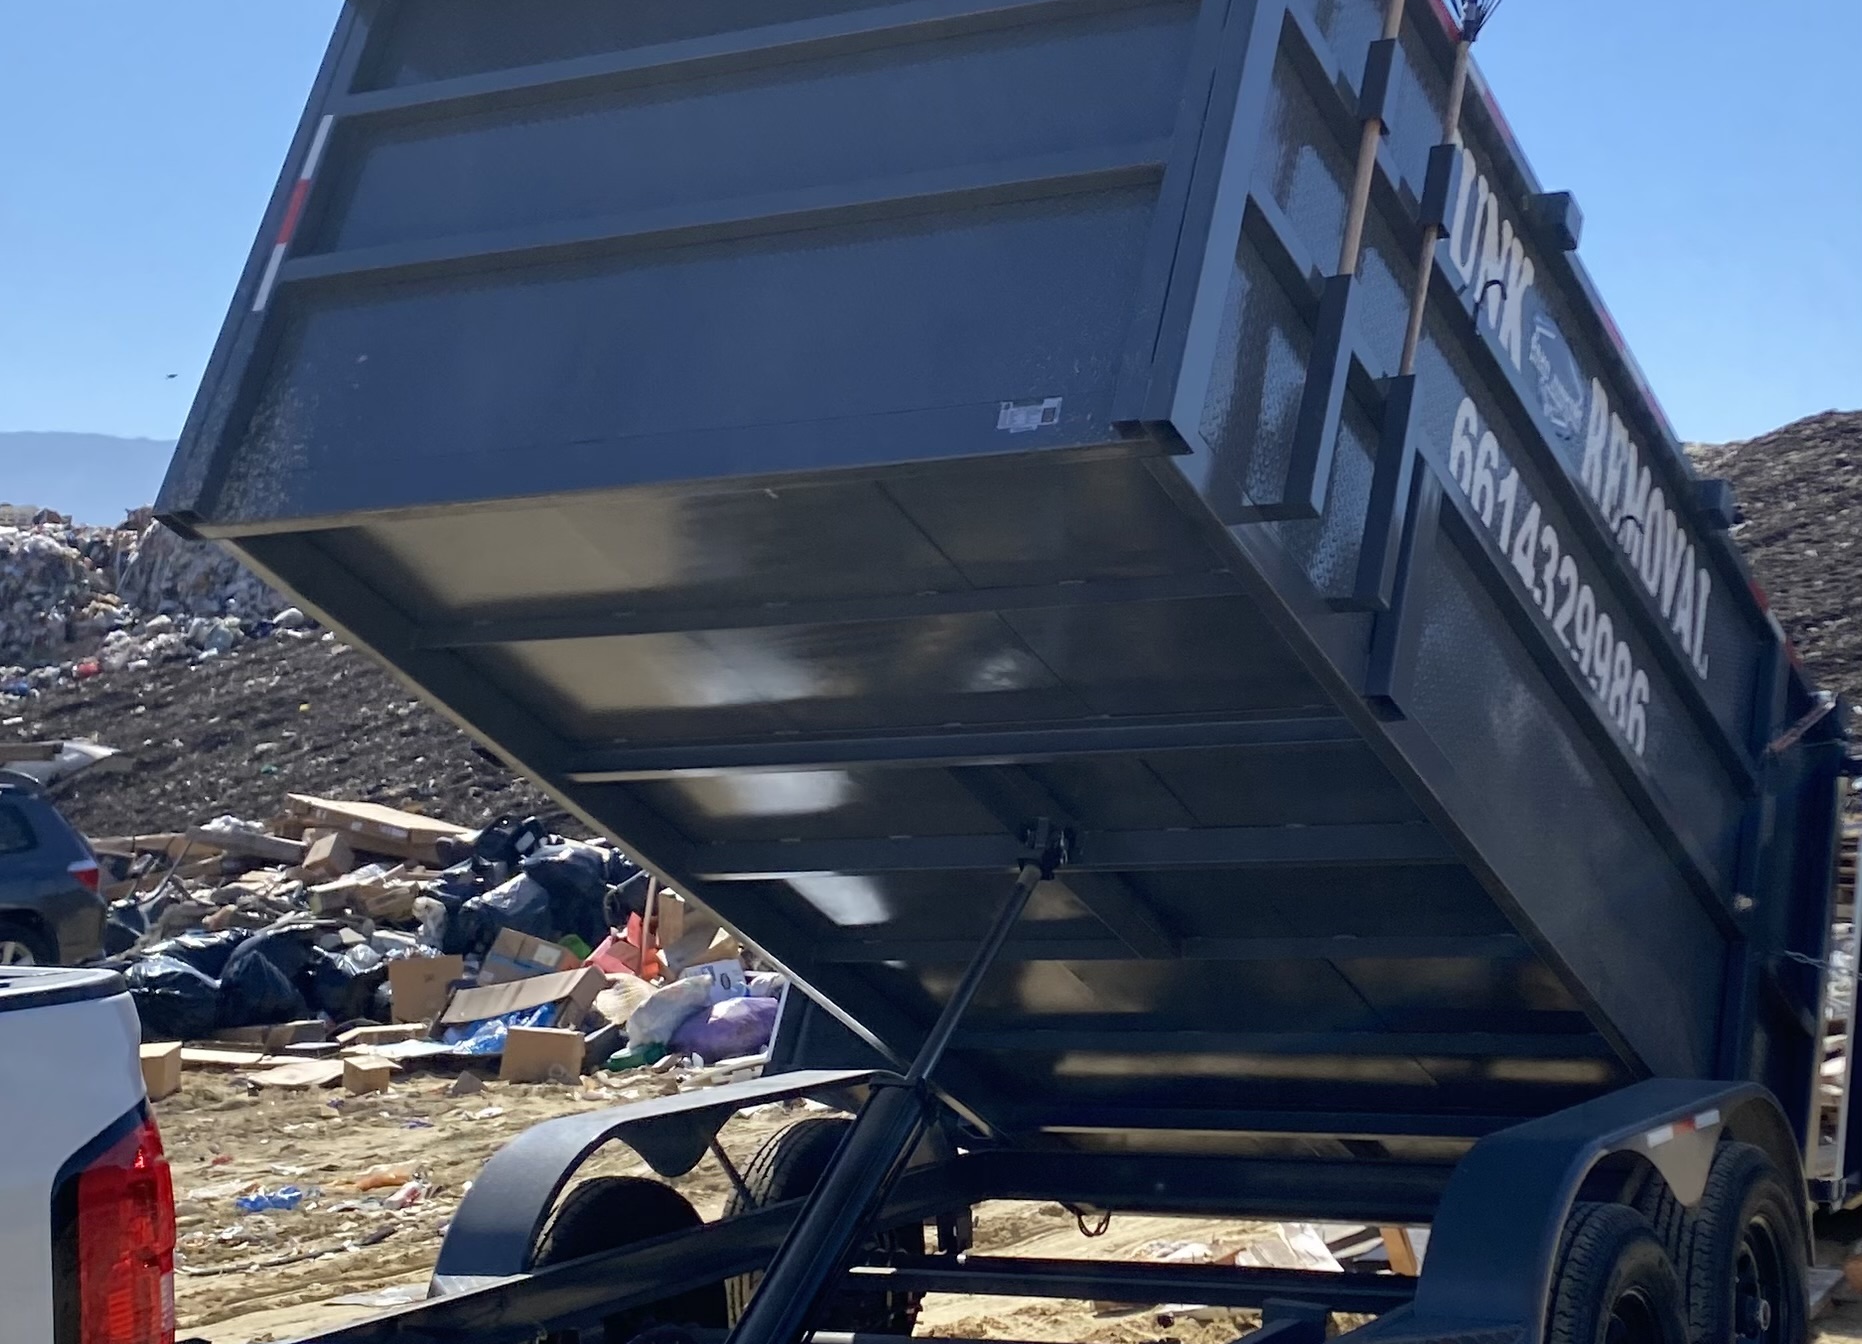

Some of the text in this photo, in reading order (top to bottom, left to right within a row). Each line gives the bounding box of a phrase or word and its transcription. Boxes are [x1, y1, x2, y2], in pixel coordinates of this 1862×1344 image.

[1449, 128, 1711, 680] UNK REMOVAL
[1449, 396, 1650, 757] 6614329986
